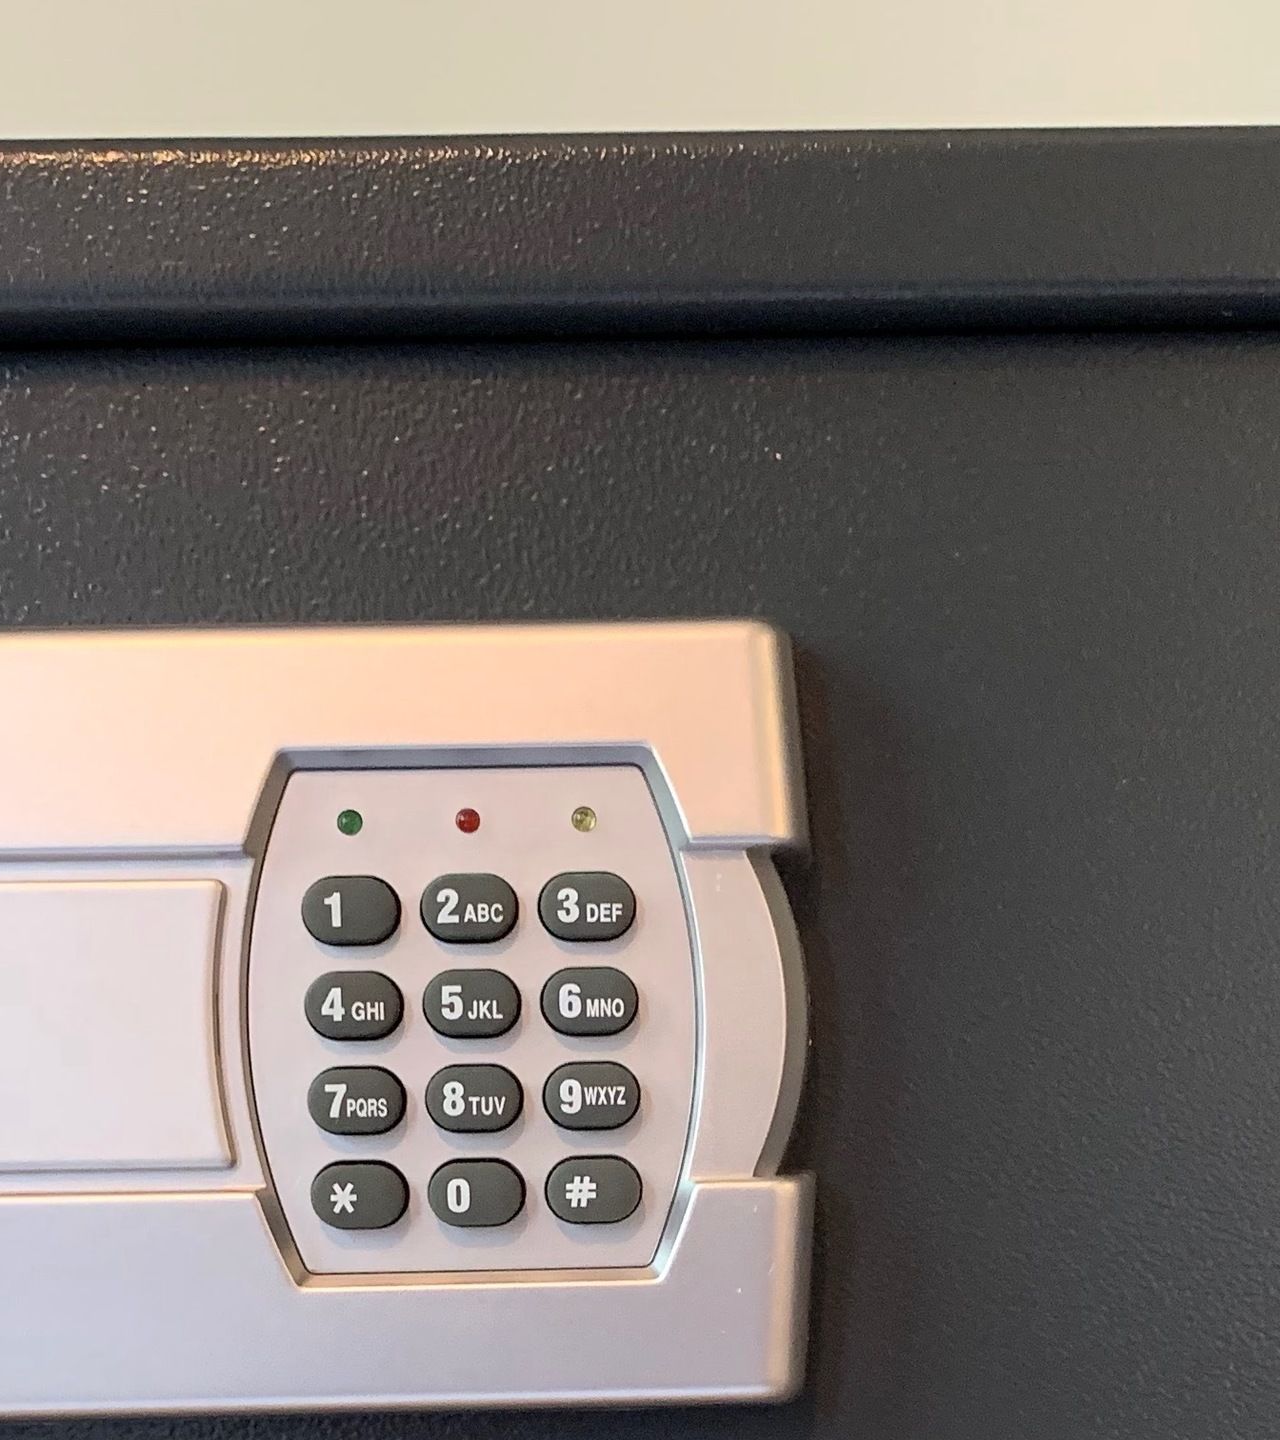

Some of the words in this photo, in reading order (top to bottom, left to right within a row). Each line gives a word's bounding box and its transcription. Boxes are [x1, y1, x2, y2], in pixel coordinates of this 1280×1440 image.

[324, 892, 341, 927] 1
[437, 889, 459, 923] 2
[464, 904, 503, 922] ABC
[557, 888, 579, 923] 3
[587, 903, 622, 922] DEF
[322, 988, 345, 1021] 4
[352, 1002, 384, 1021] GHI
[442, 986, 463, 1019] 5
[468, 1000, 503, 1019] JKL
[559, 984, 581, 1018] 6
[587, 998, 624, 1017] MNO
[325, 1084, 346, 1118] 7
[347, 1098, 387, 1117] PQRS
[443, 1082, 465, 1116] 8
[469, 1096, 505, 1115] TUV
[560, 1079, 582, 1113] 9
[584, 1086, 625, 1105] WXYZ
[447, 1179, 470, 1212] 0
[566, 1176, 596, 1207] #
